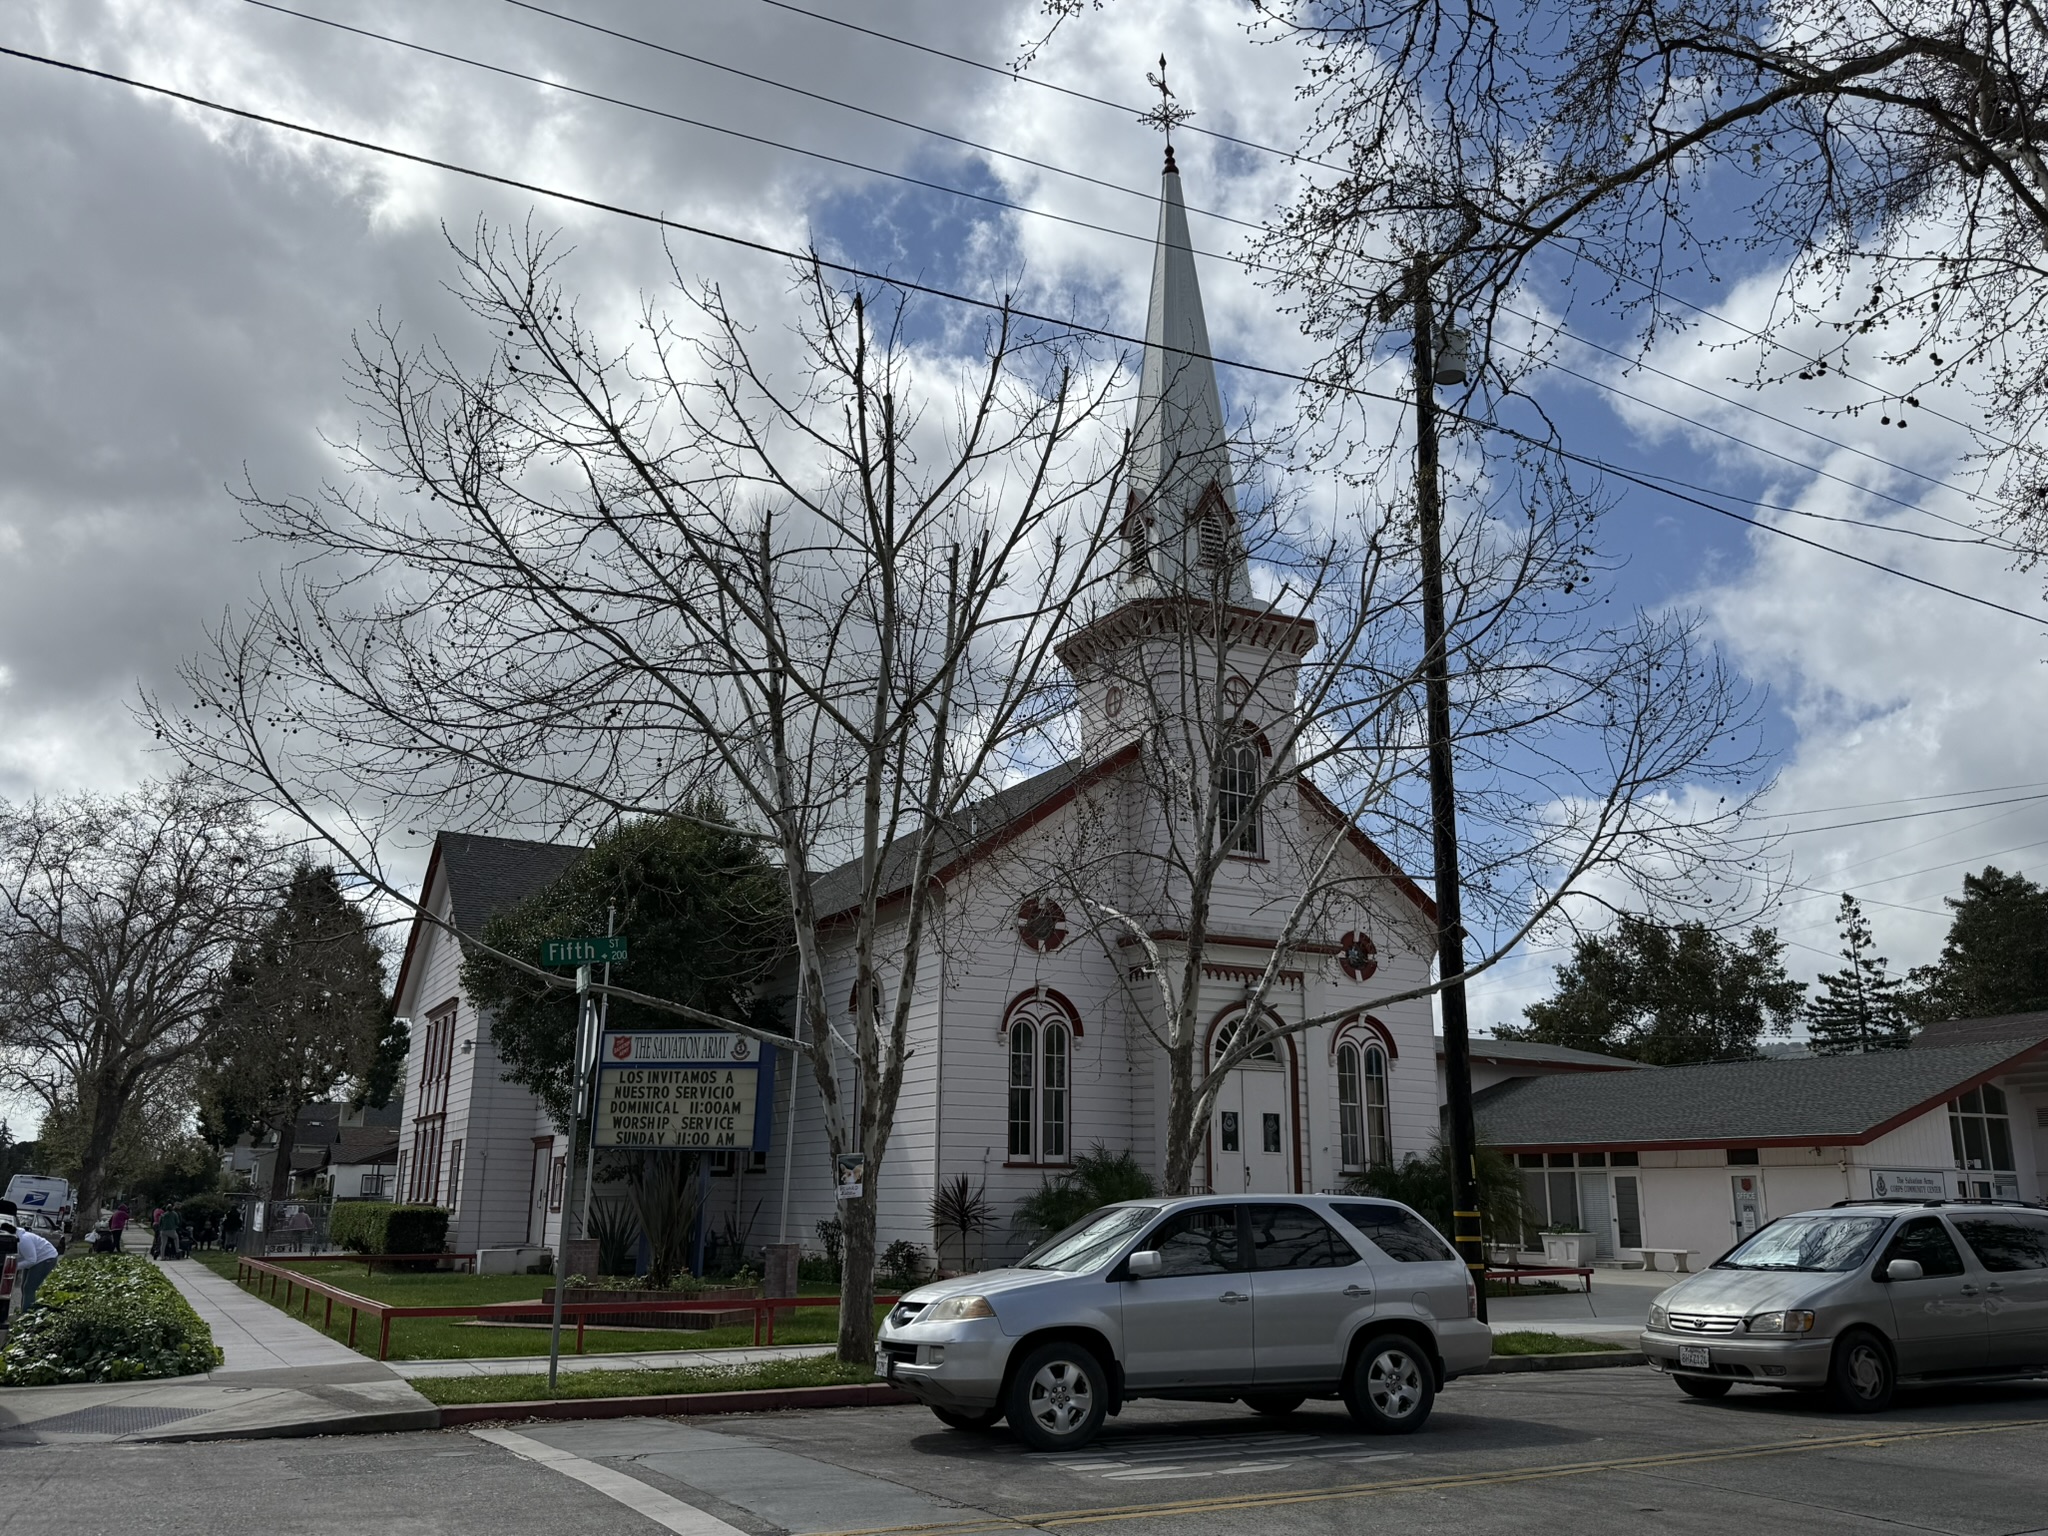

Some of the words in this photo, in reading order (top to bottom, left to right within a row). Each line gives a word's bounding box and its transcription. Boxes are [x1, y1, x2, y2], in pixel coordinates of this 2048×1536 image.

[549, 941, 595, 961] Fifth
[609, 938, 619, 949] ST
[611, 950, 627, 960] 200
[634, 1036, 652, 1059] THE
[652, 1036, 701, 1059] SALVATION
[701, 1036, 729, 1059] ARMY
[619, 1070, 644, 1084] LOS
[647, 1070, 717, 1084] INVITAMOS
[725, 1071, 734, 1084] A
[614, 1085, 670, 1099] NUESTRO
[675, 1086, 735, 1099] SERVICIO
[610, 1100, 679, 1114] DOMINICAL
[690, 1101, 741, 1114] 11:00AM
[612, 1116, 670, 1130] WORSHIP
[681, 1116, 734, 1130] SERVICE
[615, 1131, 665, 1145] SUNDAY
[677, 1132, 710, 1145] 11:00
[716, 1132, 735, 1146] AM
[1896, 1176, 1904, 1184] The
[1904, 1176, 1922, 1184] Salvation
[1736, 1192, 1756, 1200] OFFICE
[1904, 1185, 1926, 1193] COMMUNITY
[1926, 1185, 1941, 1193] CENTER
